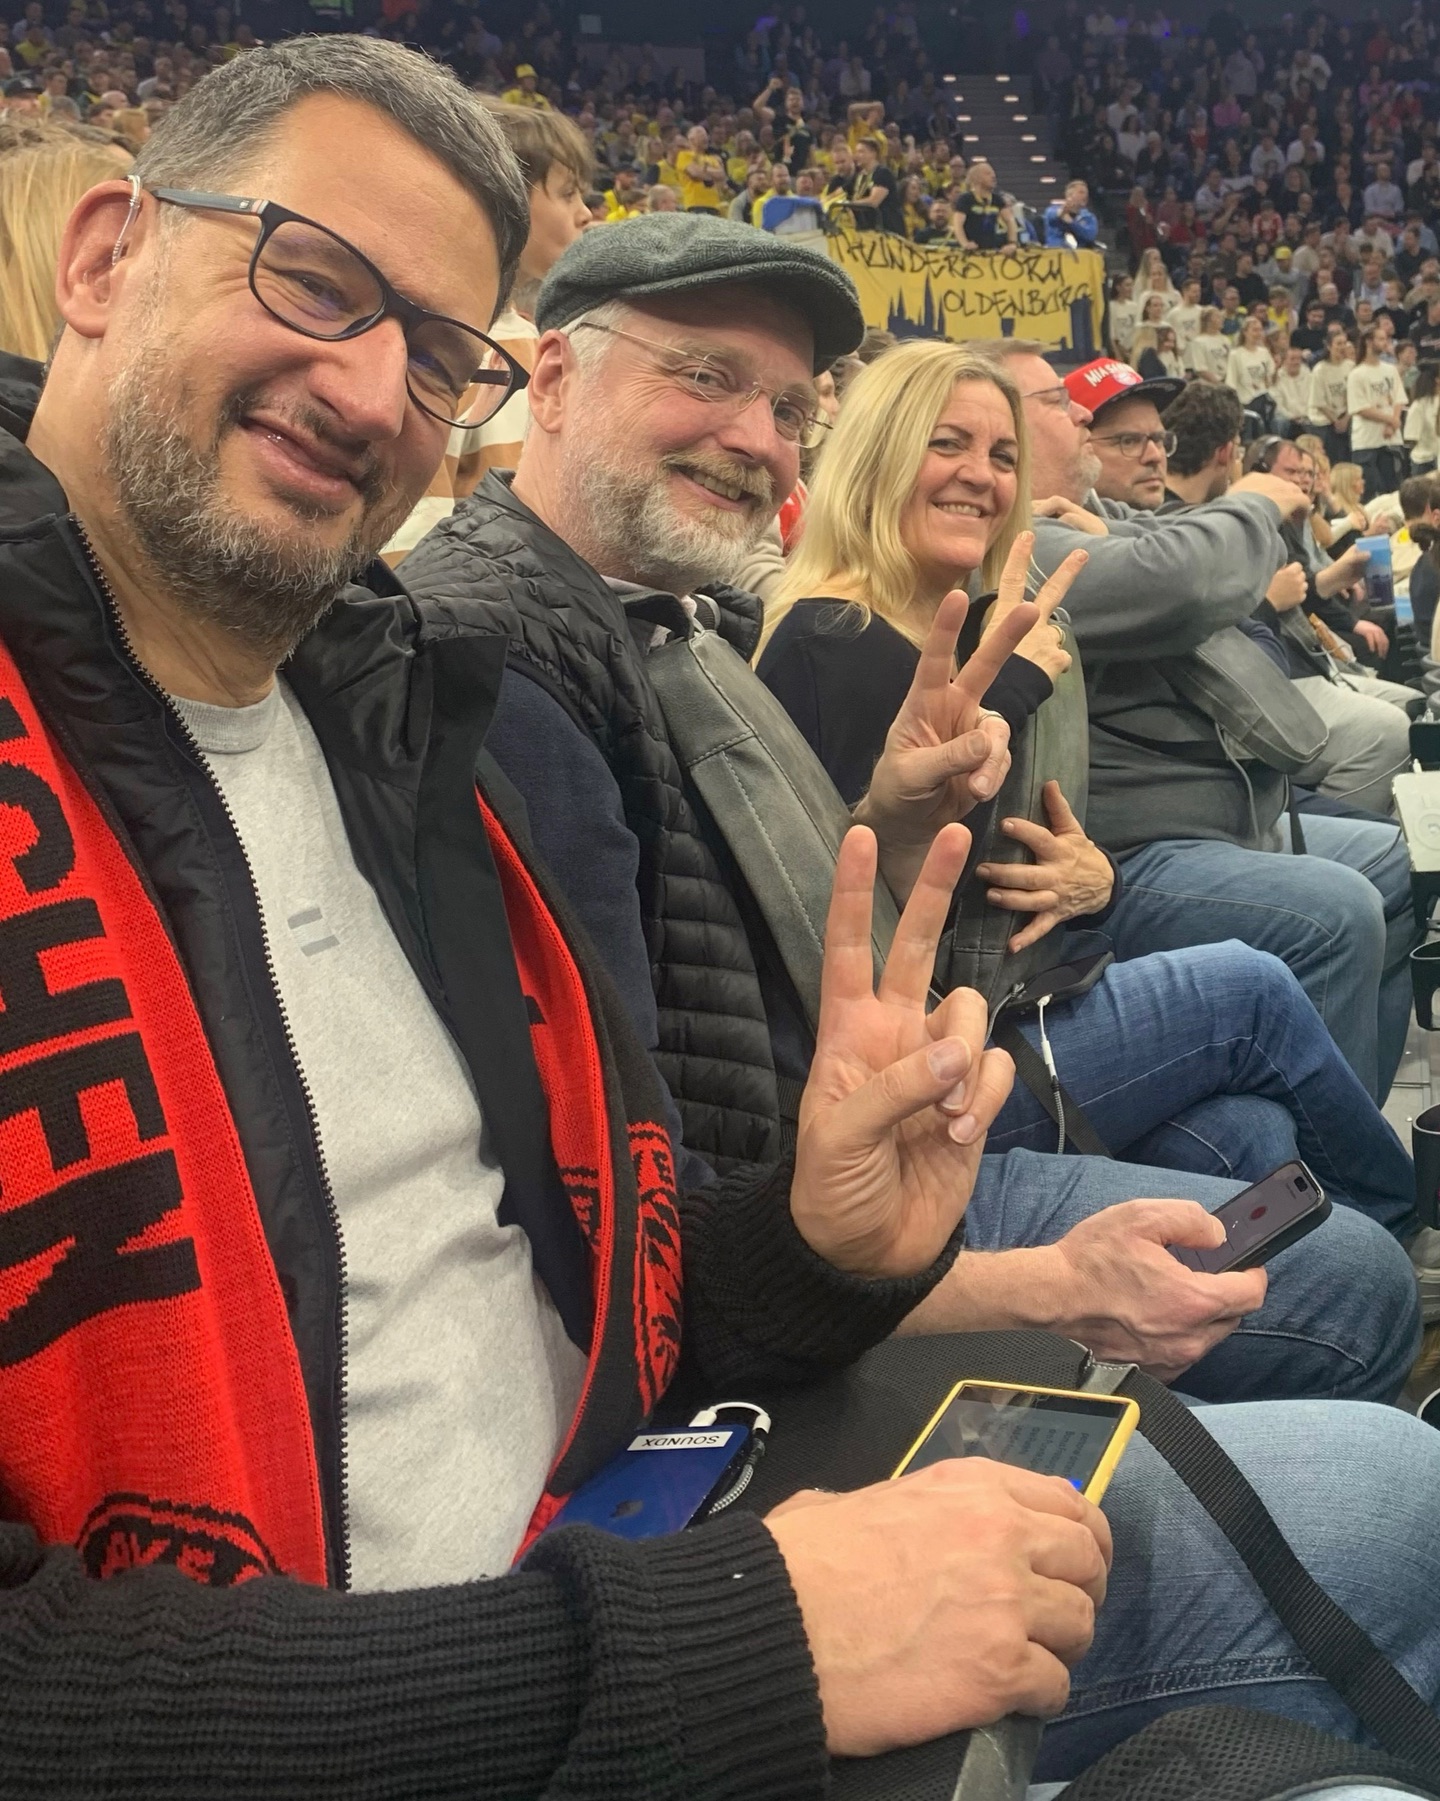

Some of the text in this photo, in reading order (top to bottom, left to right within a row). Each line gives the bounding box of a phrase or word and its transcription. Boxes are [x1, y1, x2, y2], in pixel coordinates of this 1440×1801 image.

[943, 283, 1092, 318] OLDENBURG
[1083, 366, 1110, 388] MIA
[0, 694, 202, 1368] CHEN
[642, 1435, 720, 1447] SOUNDX
